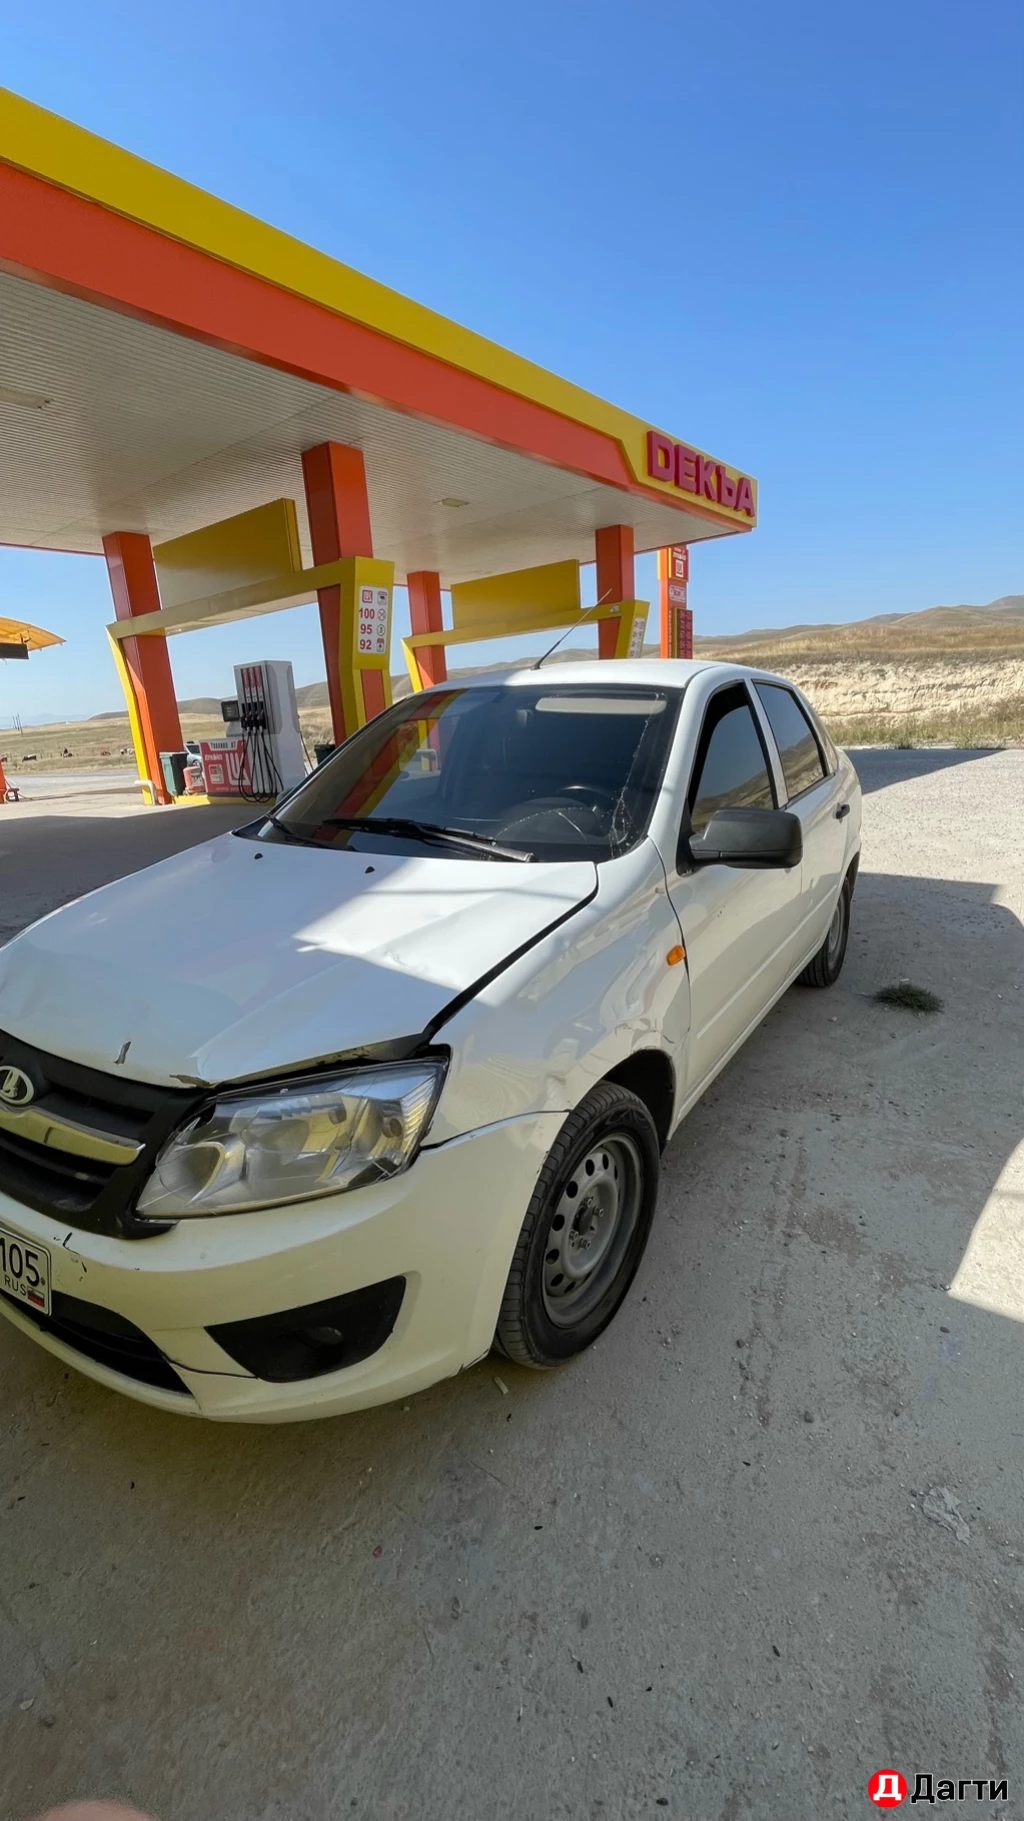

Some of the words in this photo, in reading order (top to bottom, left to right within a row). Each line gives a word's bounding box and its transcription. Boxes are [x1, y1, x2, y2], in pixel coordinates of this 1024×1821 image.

[359, 607, 375, 619] 100
[360, 623, 372, 634] 95
[360, 639, 372, 650] 92
[0, 1237, 40, 1287] 105
[4, 1274, 27, 1296] RUS
